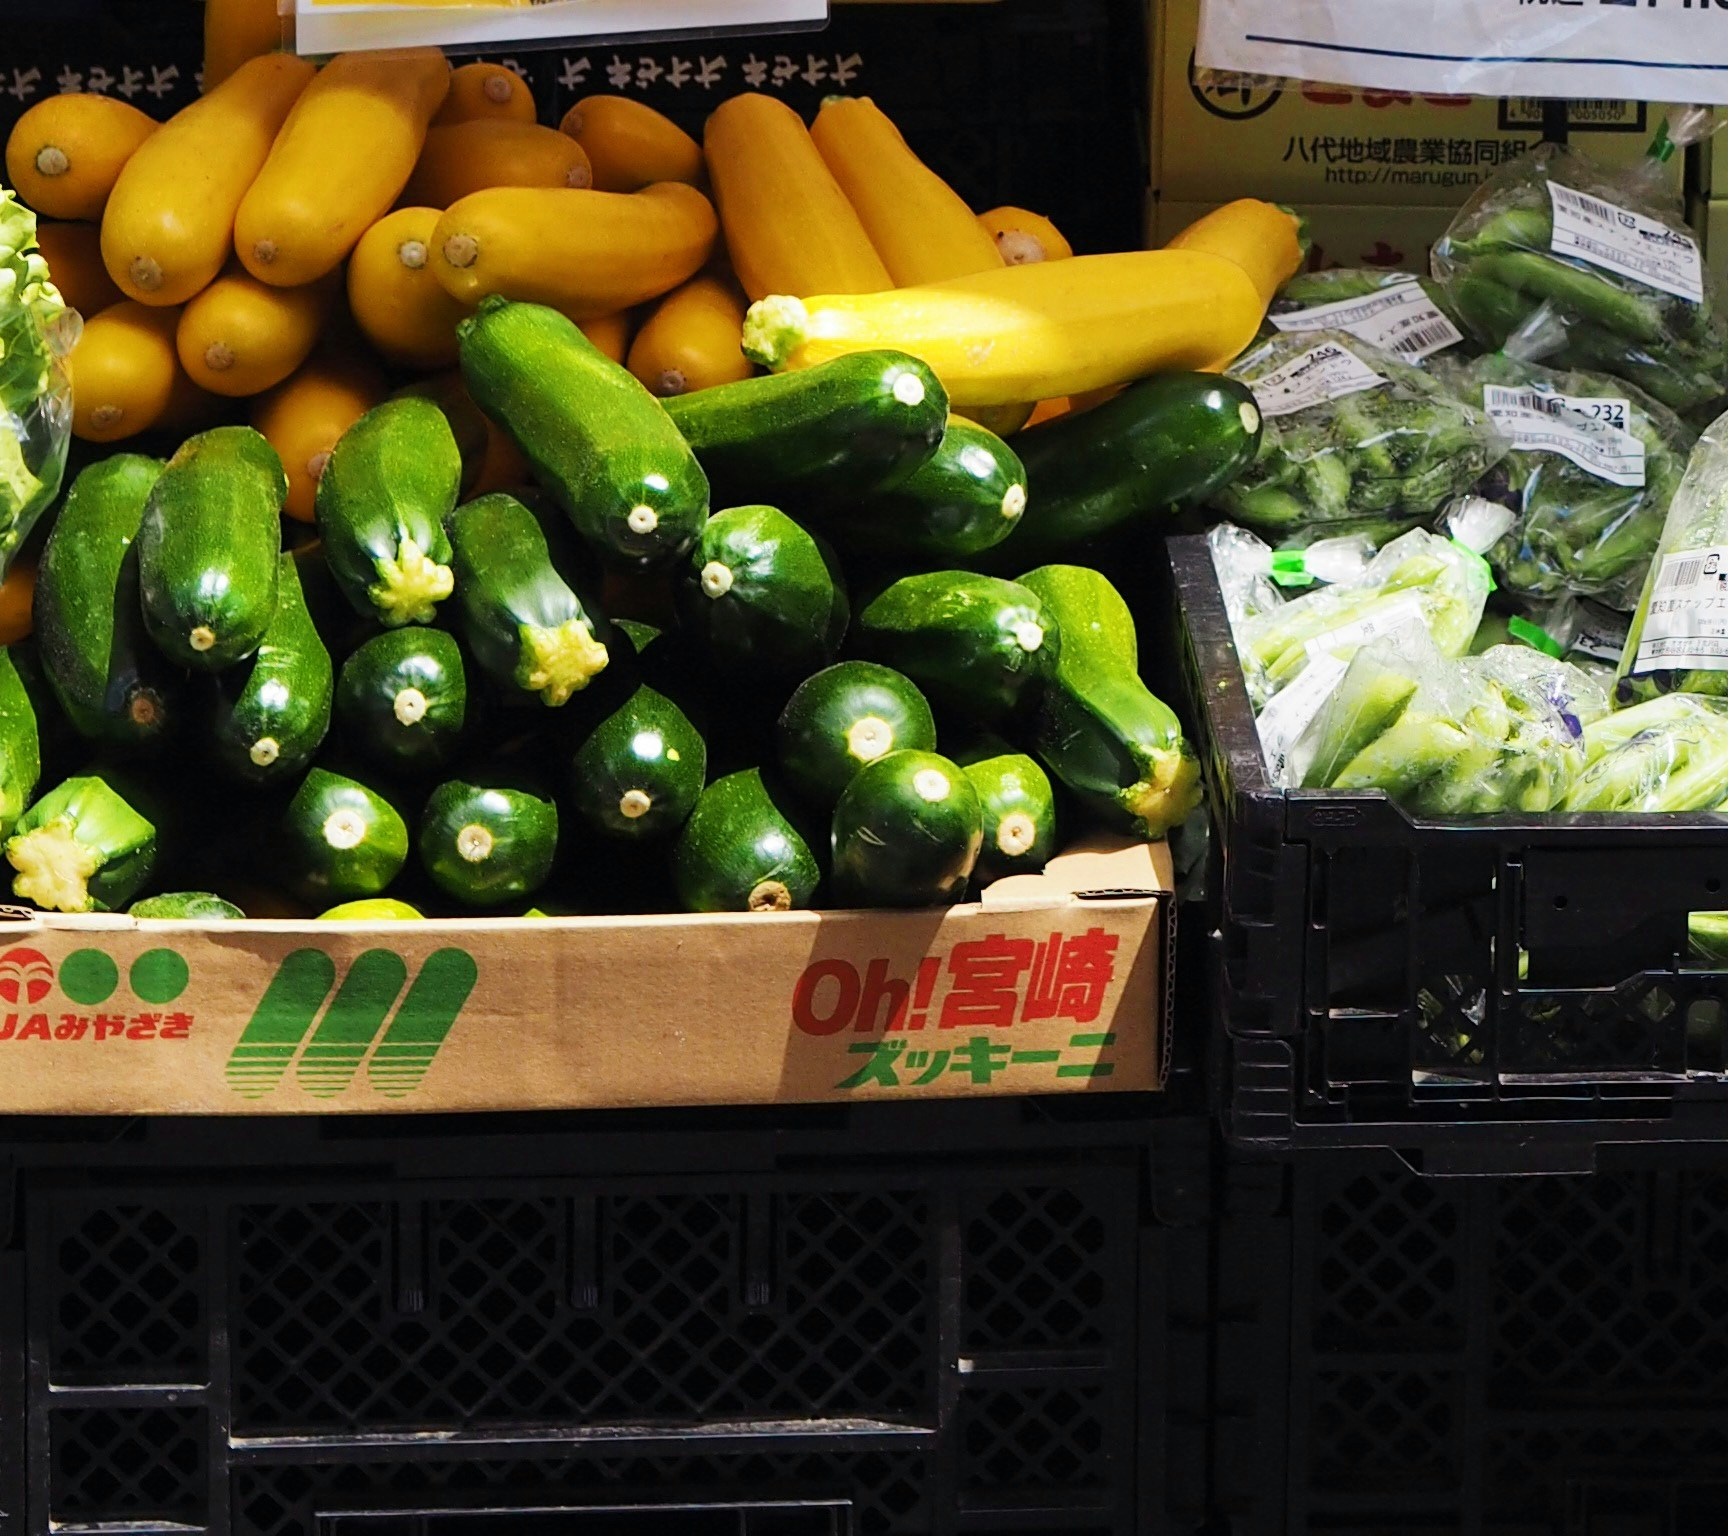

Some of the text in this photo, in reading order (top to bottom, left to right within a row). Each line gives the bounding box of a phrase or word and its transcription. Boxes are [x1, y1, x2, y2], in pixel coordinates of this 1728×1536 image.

[606, 52, 728, 92] オオゼキ
[740, 51, 865, 89] オオゼキ
[792, 926, 1121, 1038] Oh!宮崎
[834, 1032, 1117, 1090] ズッキーニ
